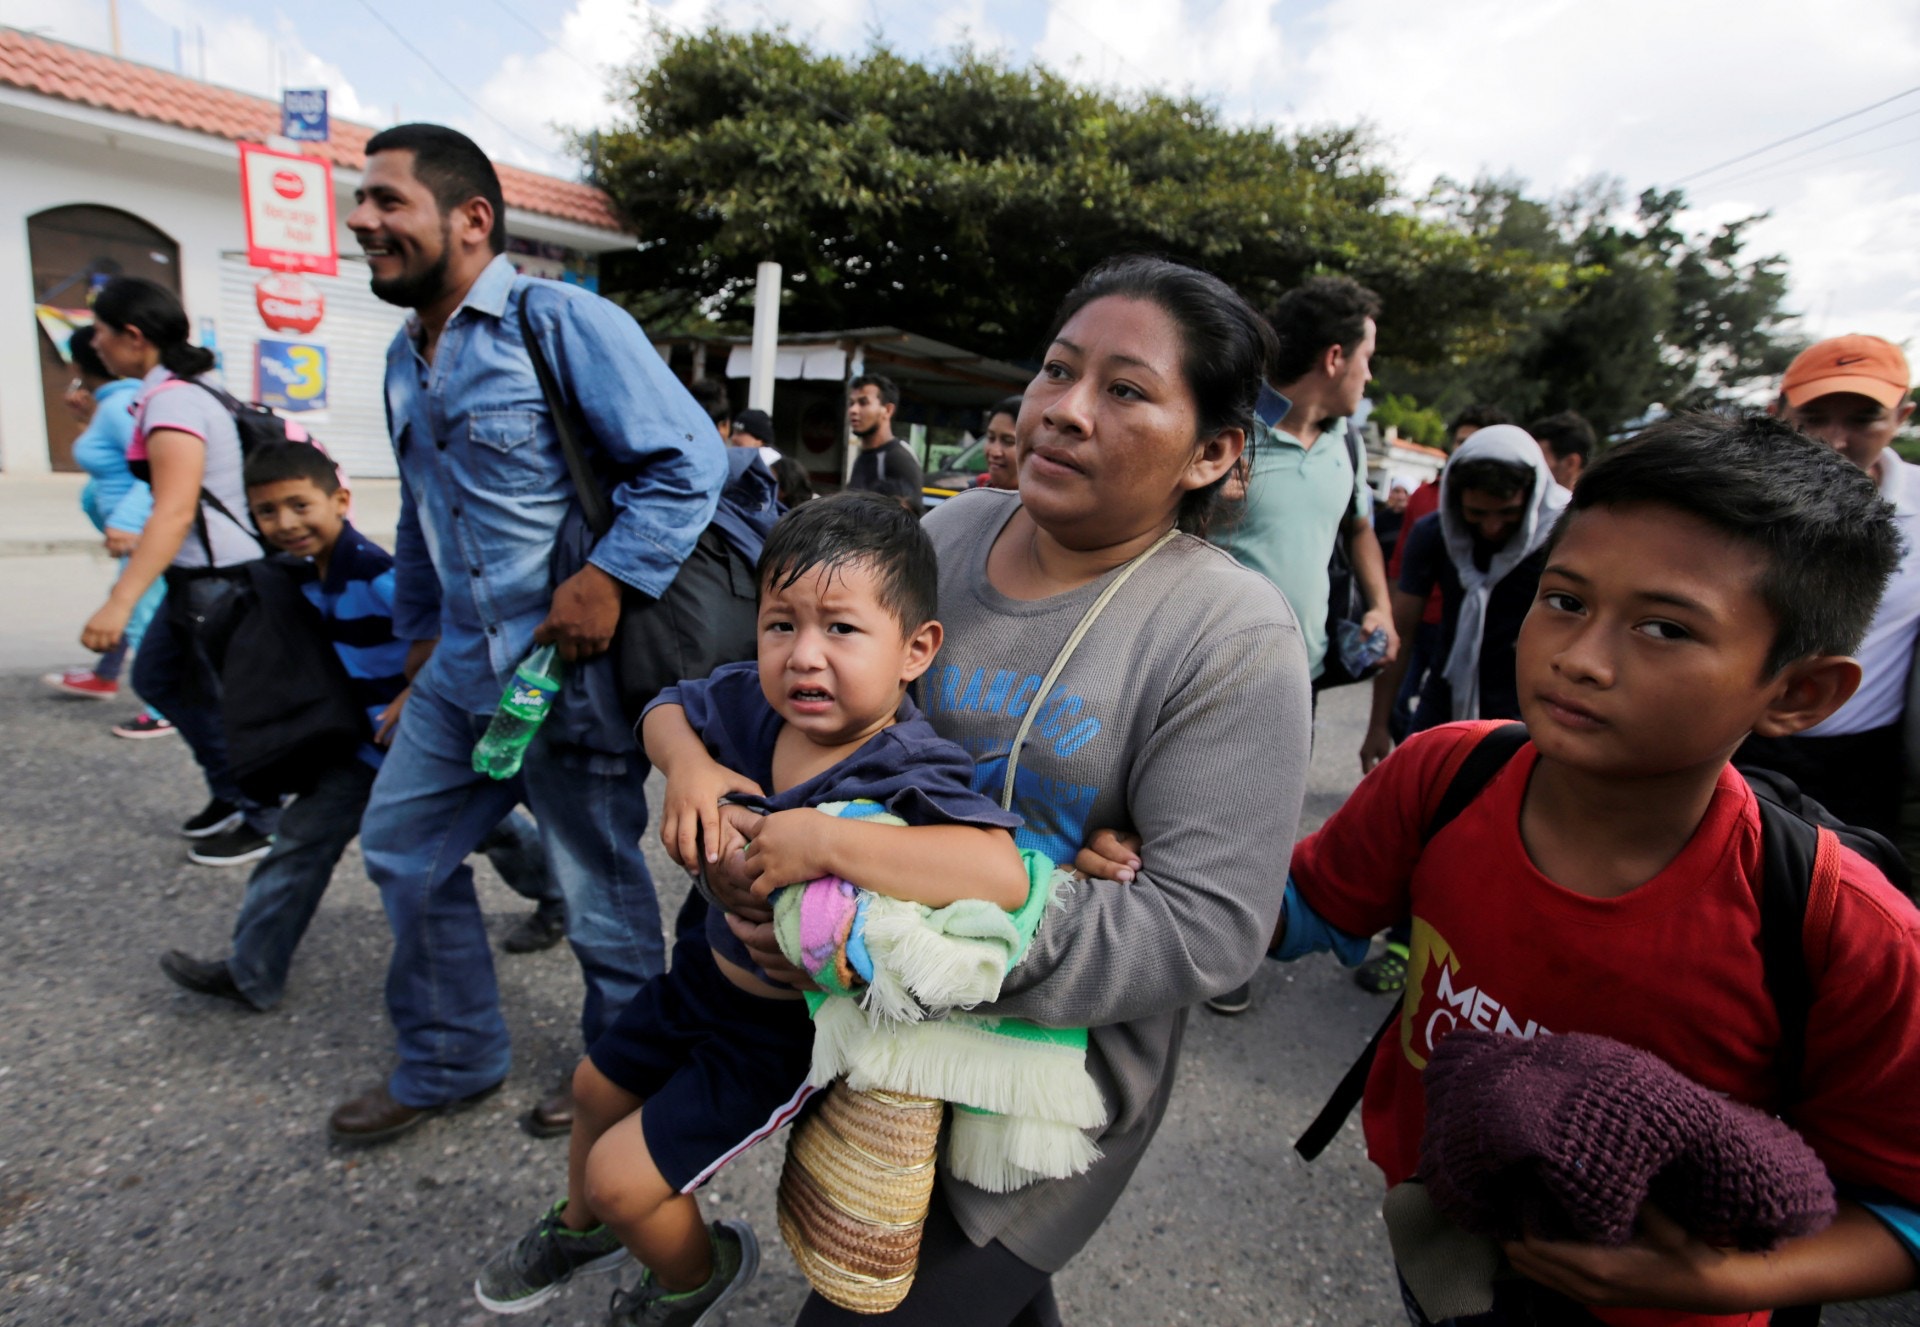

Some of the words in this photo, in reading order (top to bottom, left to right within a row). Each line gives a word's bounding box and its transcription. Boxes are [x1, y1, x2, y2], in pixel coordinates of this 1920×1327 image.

[286, 345, 323, 400] 3
[926, 665, 1101, 758] FRANCCO
[1436, 963, 1553, 1041] MEN
